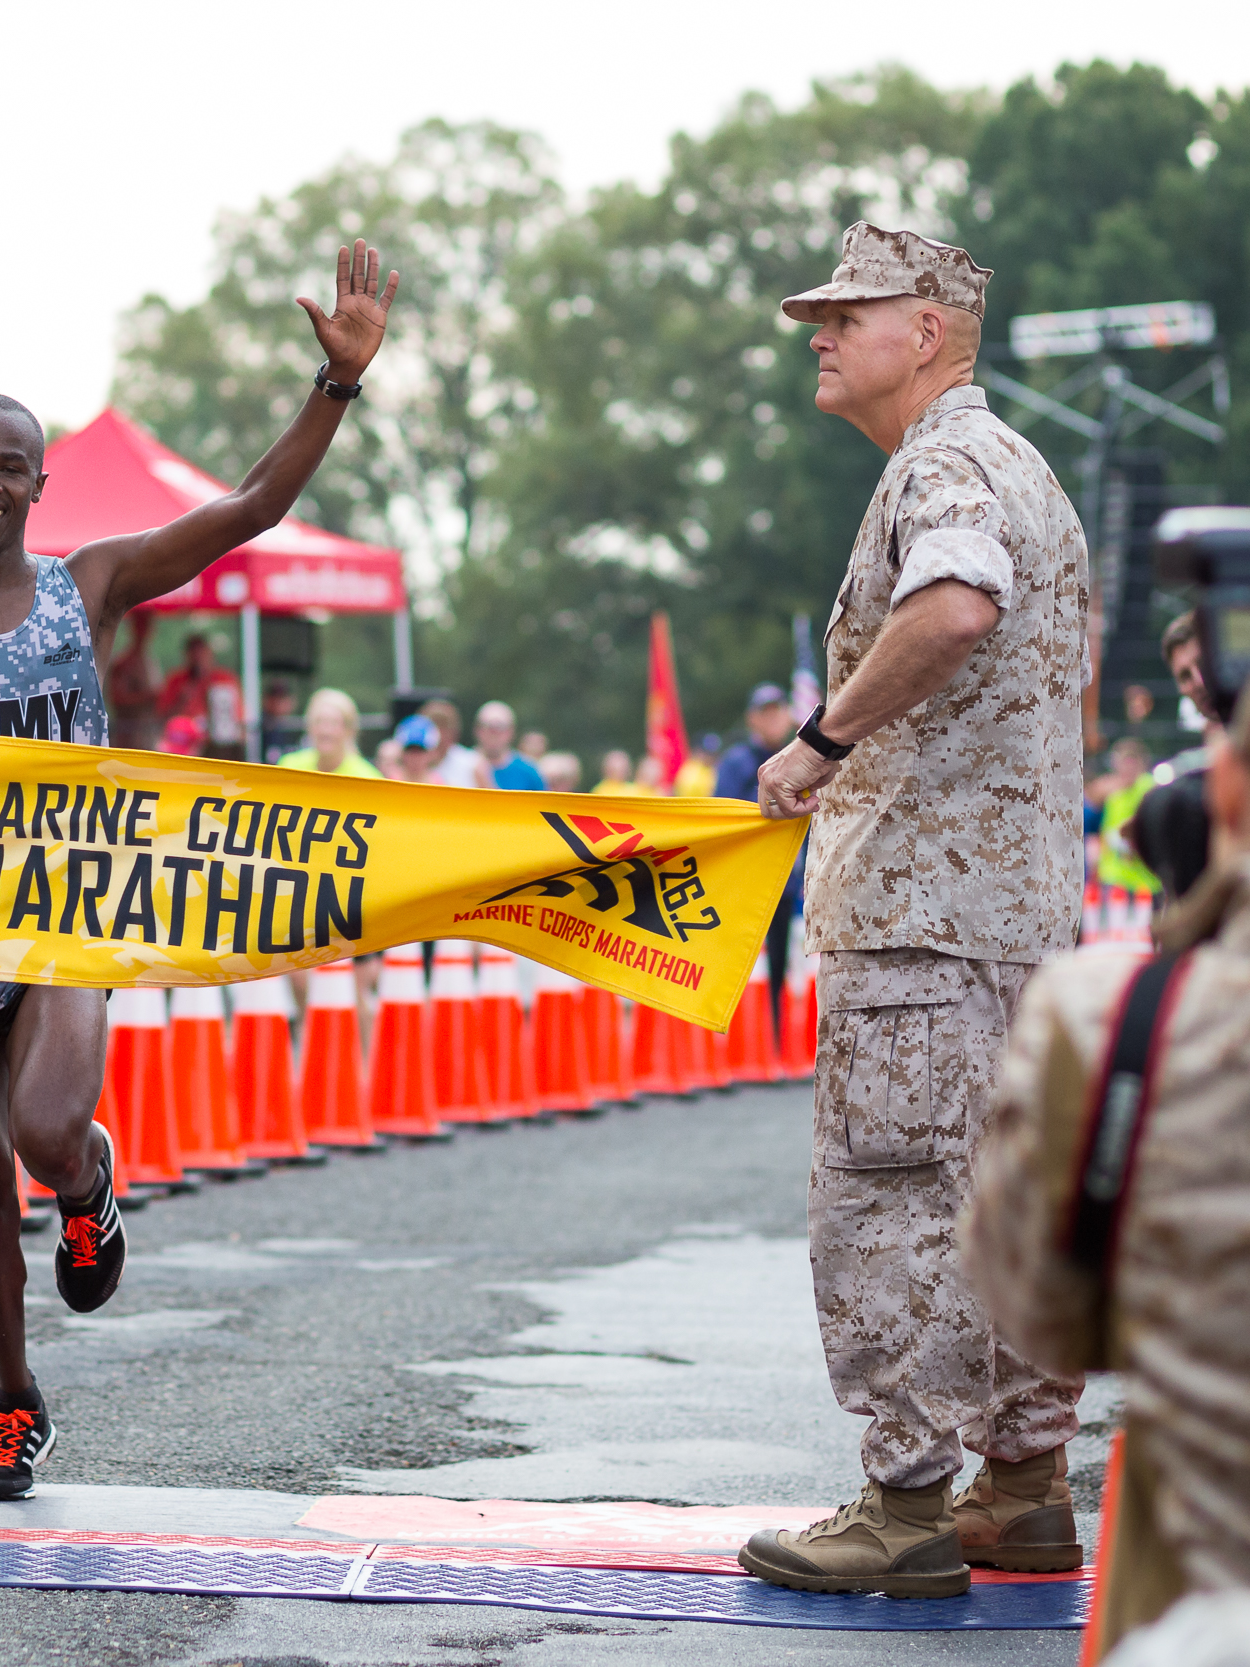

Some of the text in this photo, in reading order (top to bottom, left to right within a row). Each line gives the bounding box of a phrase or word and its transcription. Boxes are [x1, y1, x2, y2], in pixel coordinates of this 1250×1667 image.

[43, 648, 80, 664] Borah
[187, 797, 377, 869] CORPS
[658, 856, 721, 943] 26.2
[453, 904, 705, 991] MARINE CORPS MARATHON
